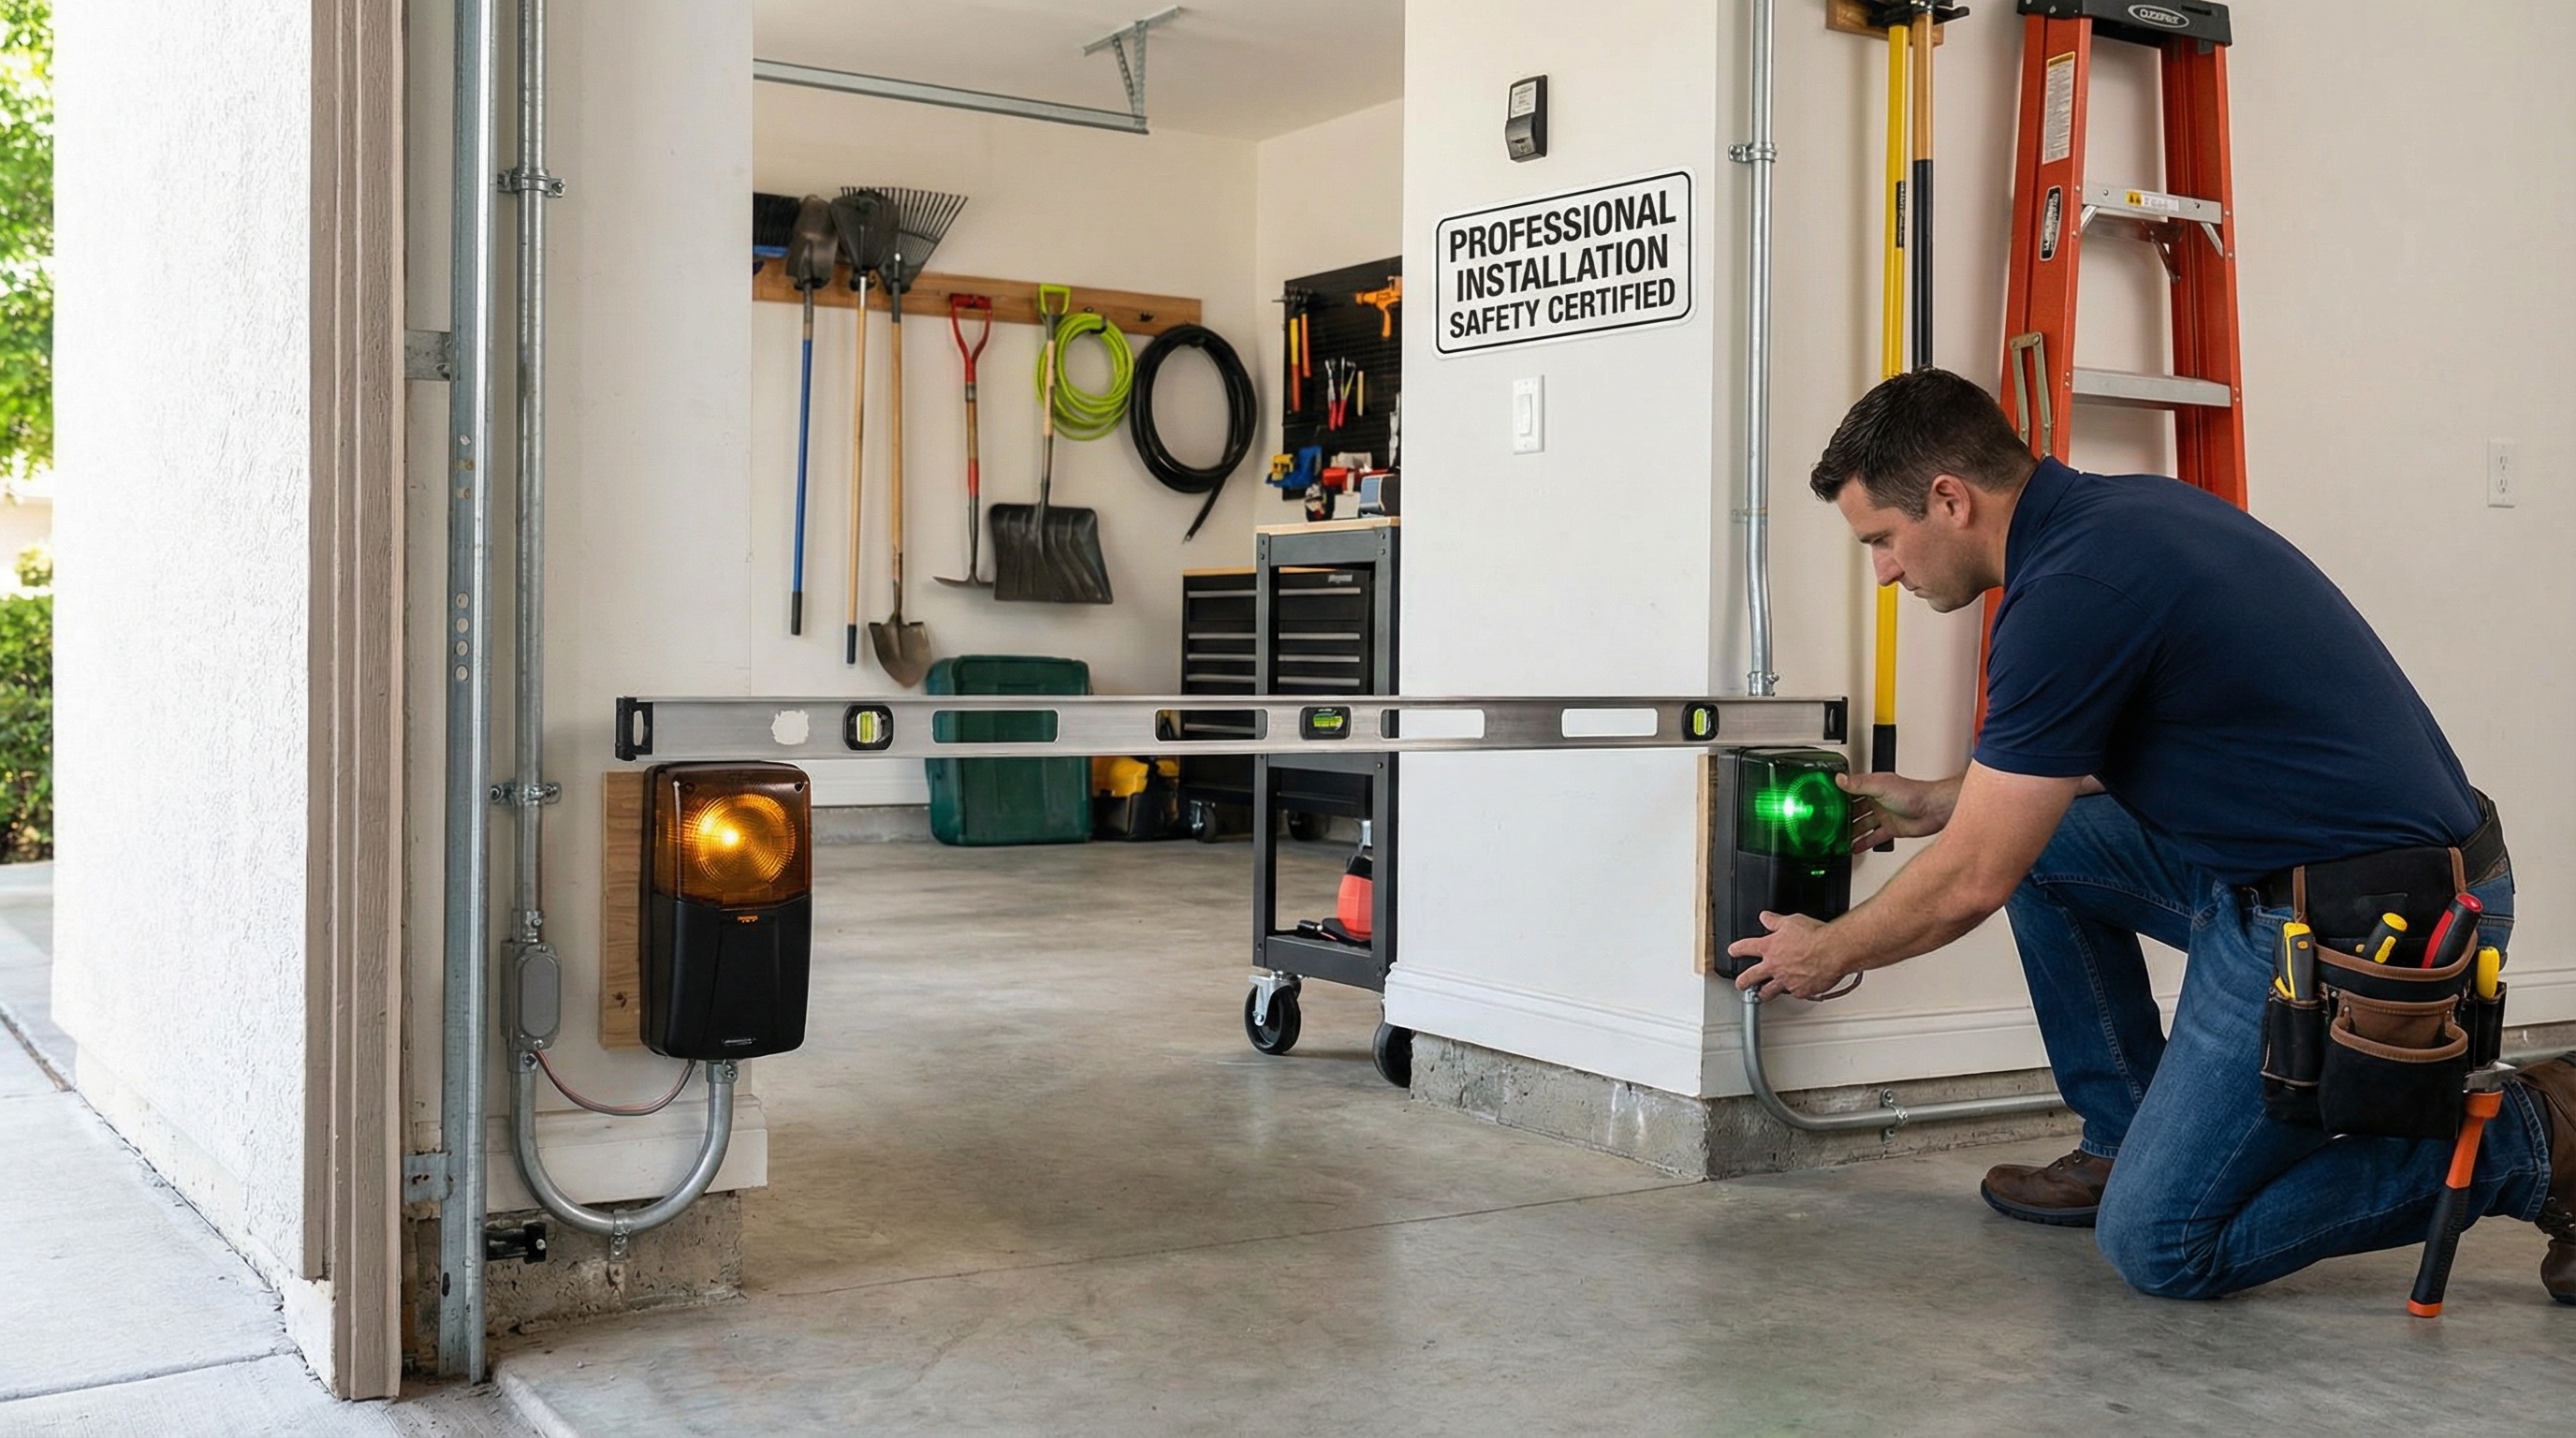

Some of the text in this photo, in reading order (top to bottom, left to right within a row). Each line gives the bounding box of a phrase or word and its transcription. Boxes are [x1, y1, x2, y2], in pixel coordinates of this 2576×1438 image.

[1450, 190, 1676, 263] PROFESSIONAL
[1456, 234, 1668, 302] INSTALLATION
[1449, 277, 1676, 339] SAFETY CERTIFIED
